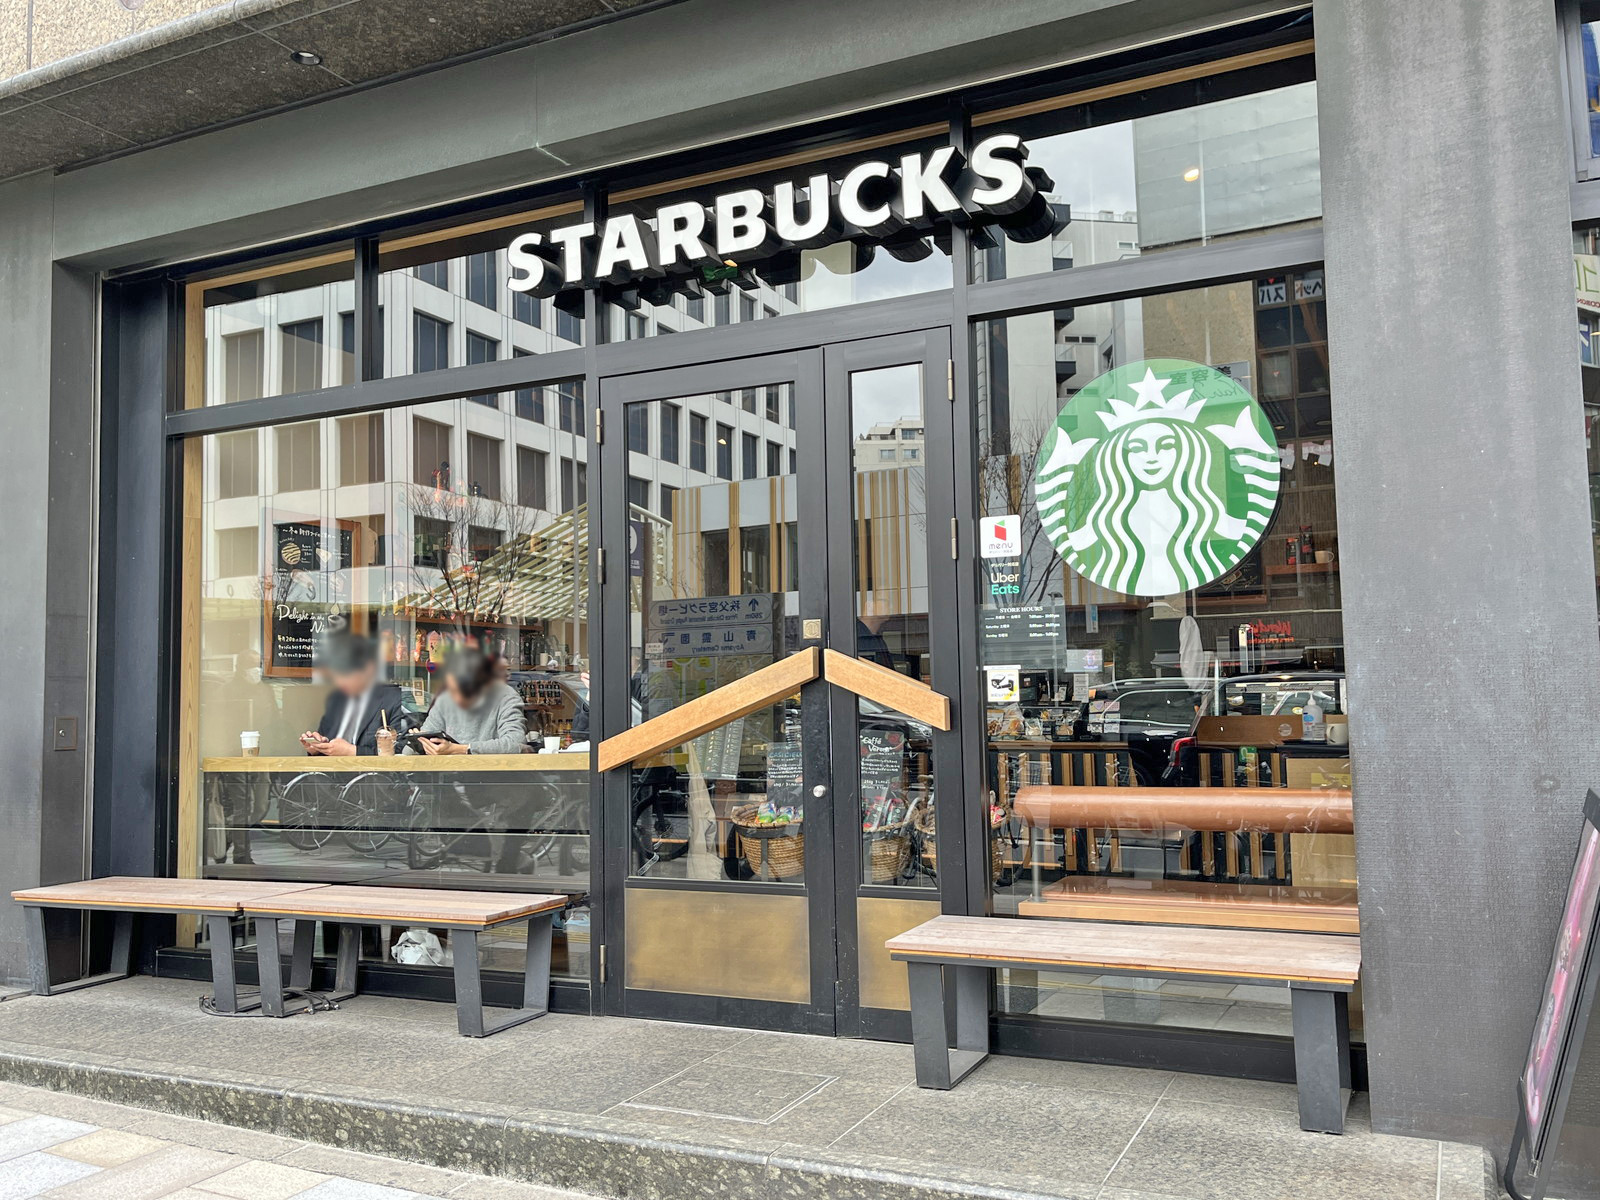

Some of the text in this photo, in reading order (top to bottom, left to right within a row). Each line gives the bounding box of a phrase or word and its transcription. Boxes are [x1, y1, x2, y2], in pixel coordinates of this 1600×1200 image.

[506, 133, 1028, 294] STARBUCKS
[988, 542, 1014, 550] menu
[990, 572, 1020, 584] Uber
[991, 584, 1020, 595] Eats
